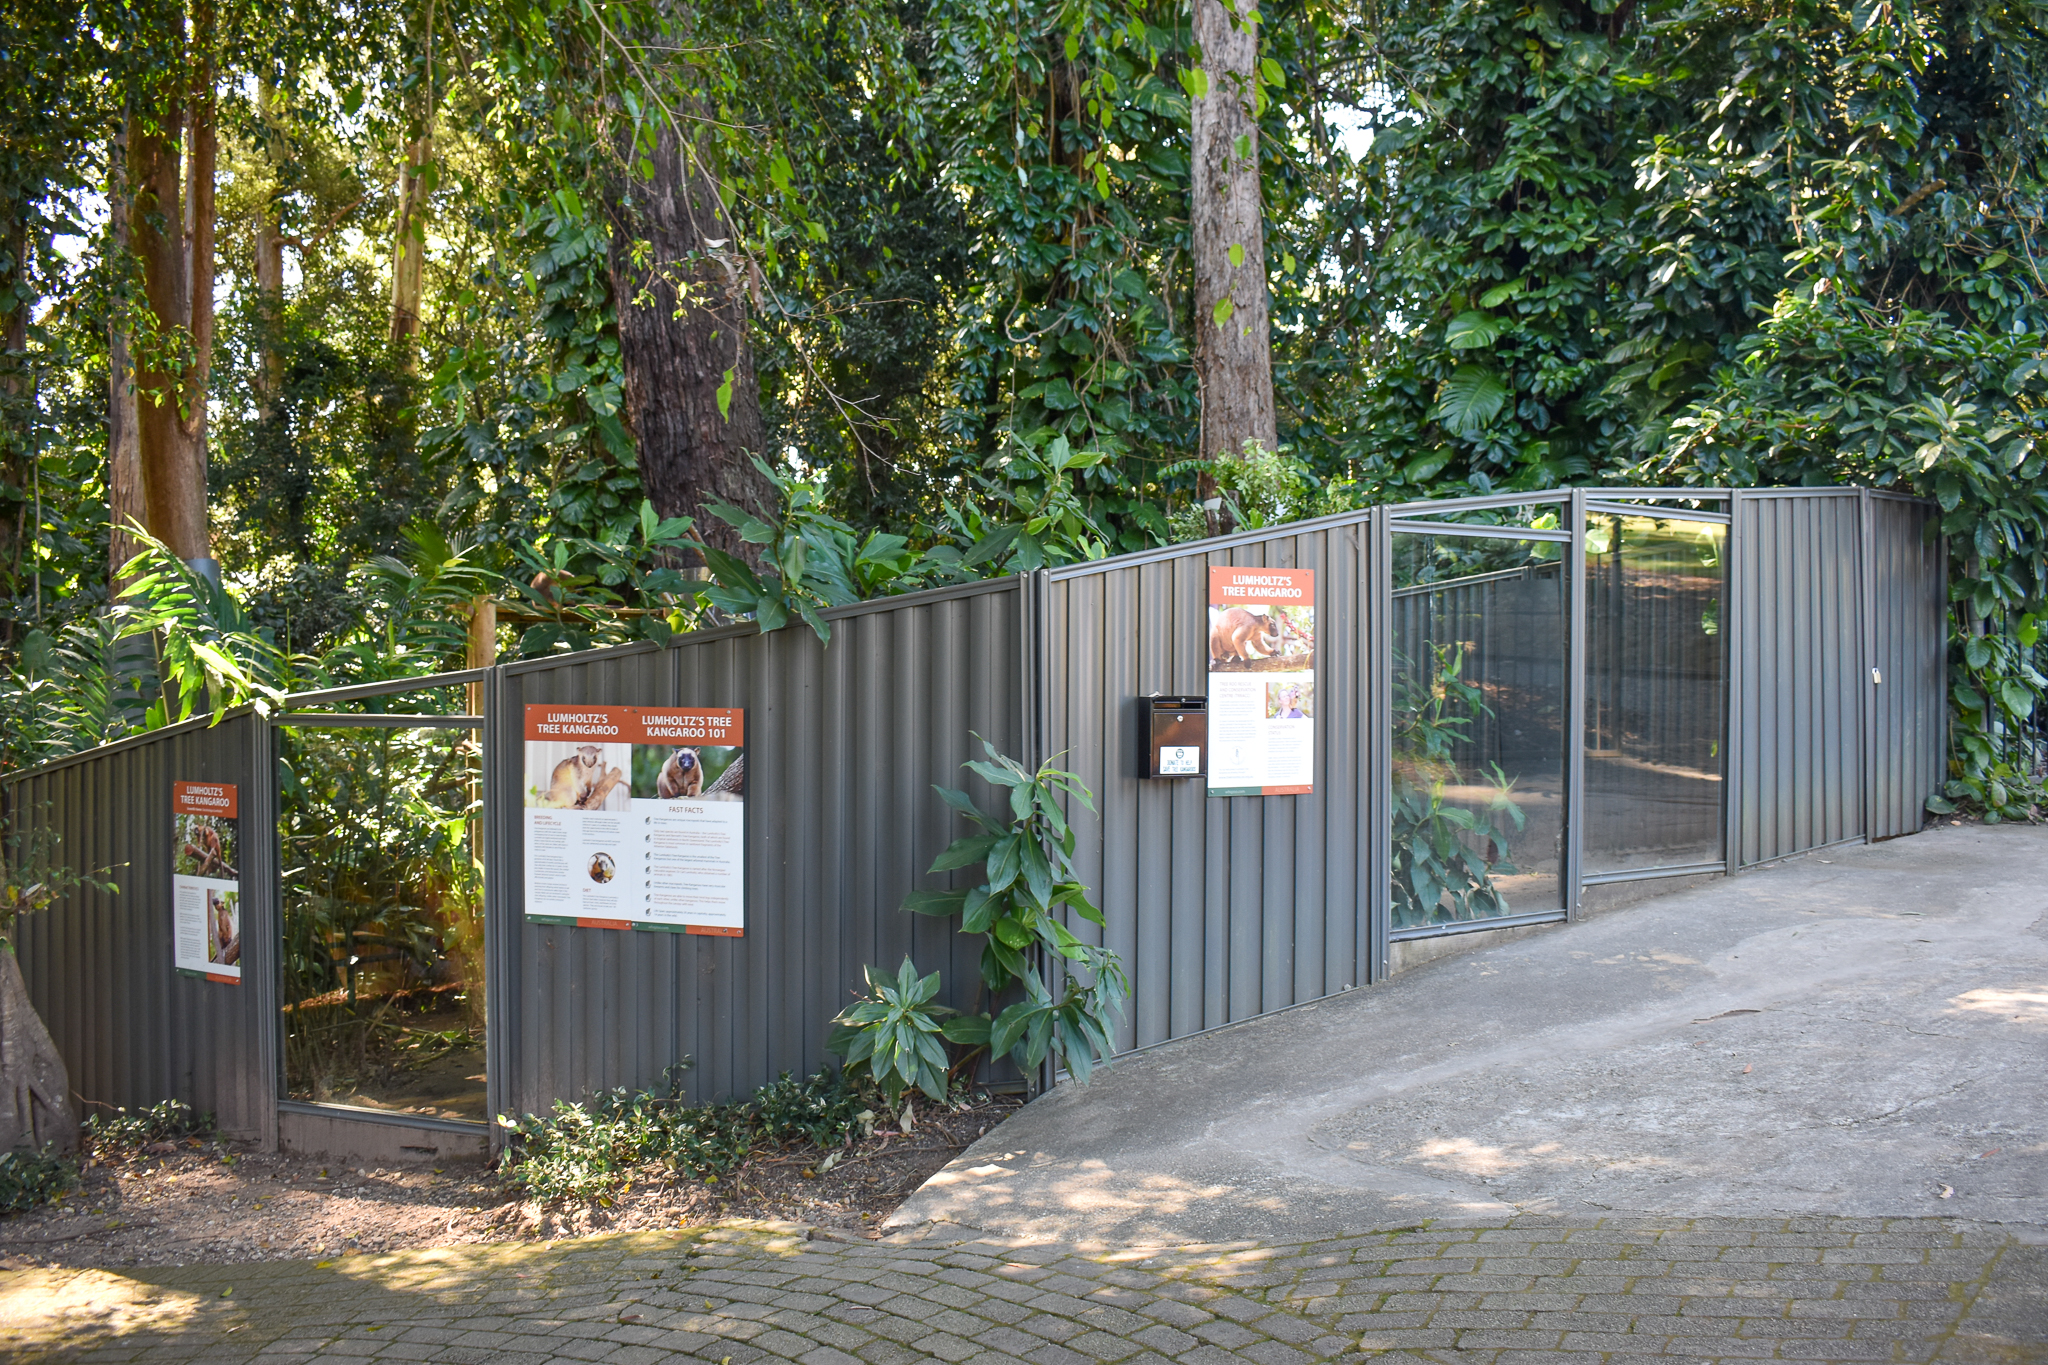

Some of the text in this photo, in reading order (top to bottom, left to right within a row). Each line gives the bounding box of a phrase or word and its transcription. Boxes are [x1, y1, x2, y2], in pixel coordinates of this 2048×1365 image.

[1232, 575, 1292, 586] LUMHOLTZ'S
[1222, 586, 1302, 598] TREE KANGAROO
[547, 713, 608, 724] LUMHOLTZ'S
[642, 715, 732, 727] LUMHOLTZ'S TREE
[537, 724, 619, 736] TREE KANGAROO
[647, 727, 726, 738] KANGAROO 101
[186, 786, 223, 796] LUMHOLTZ'S
[180, 795, 230, 807] TREE KANGAROO
